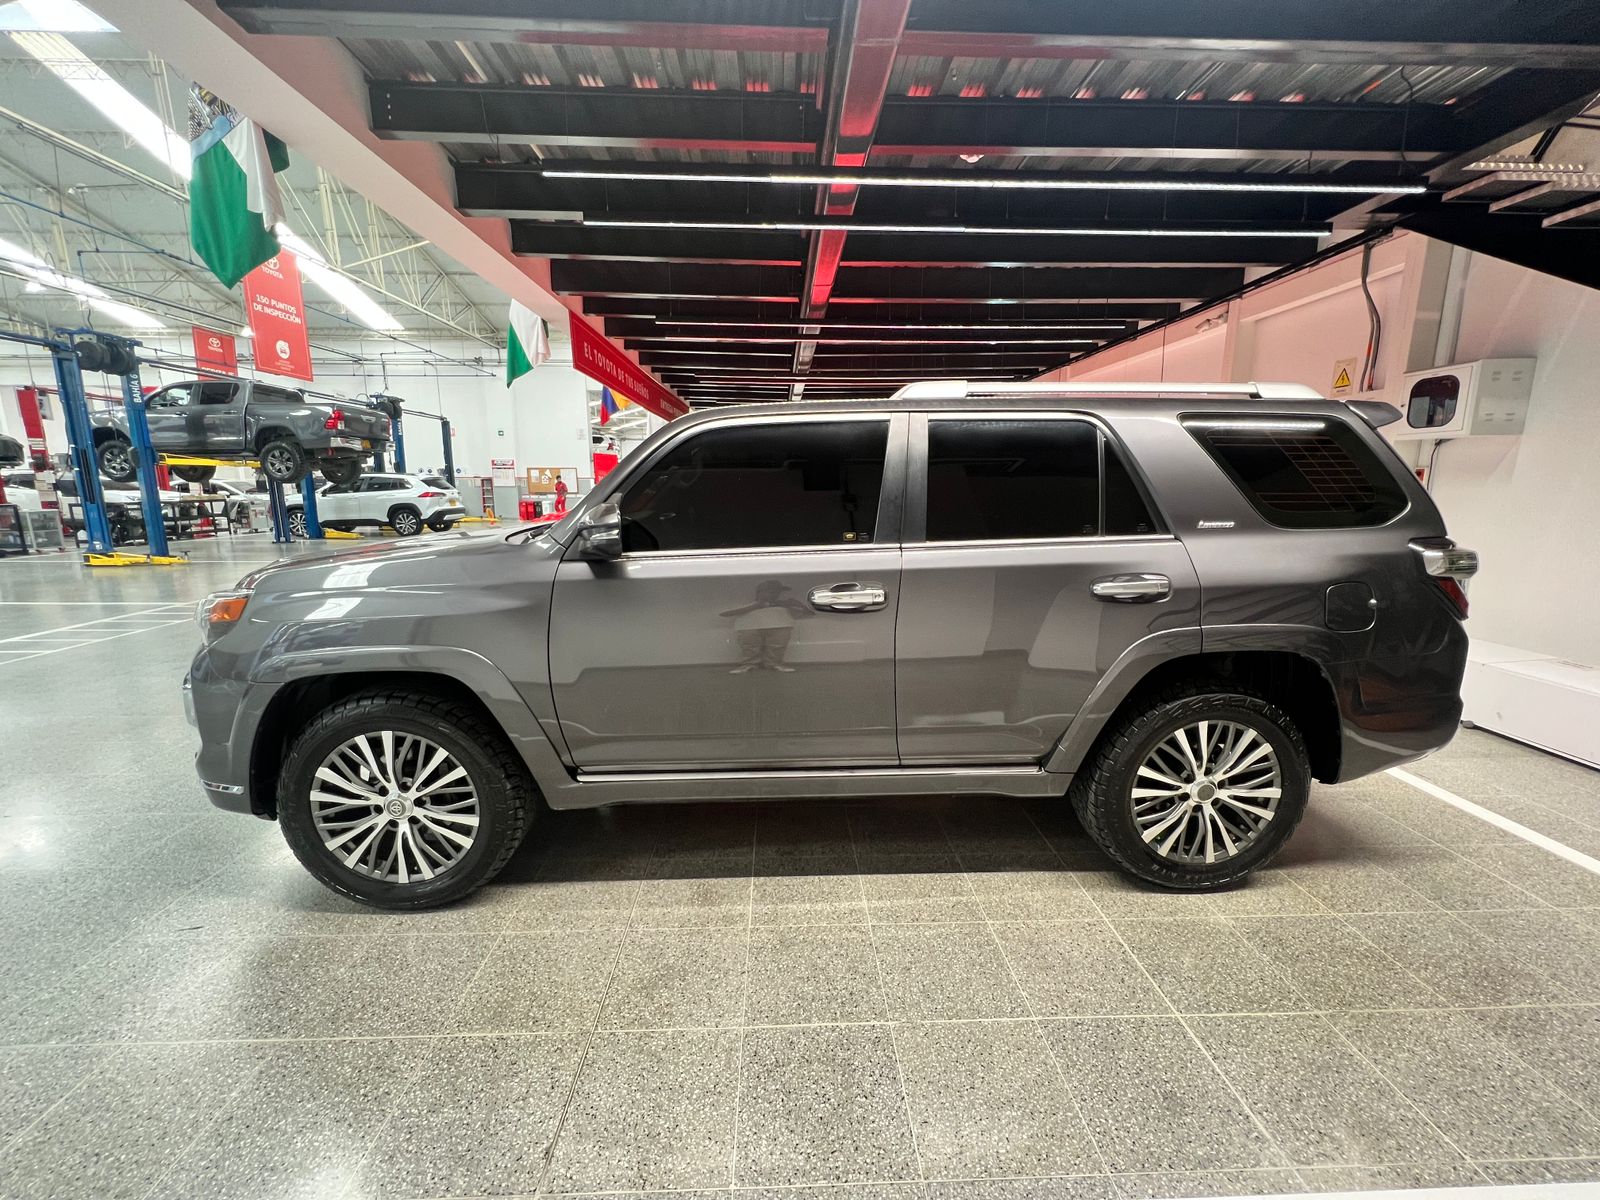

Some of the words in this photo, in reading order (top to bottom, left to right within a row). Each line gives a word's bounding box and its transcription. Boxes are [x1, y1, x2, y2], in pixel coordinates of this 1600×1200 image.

[261, 265, 284, 280] TOYOTA
[253, 302, 264, 313] DE
[264, 306, 302, 324] INSPECCIÓN
[256, 294, 270, 305] 150
[271, 298, 297, 314] PUNTOS
[583, 341, 593, 361] EL
[593, 349, 618, 378] TOYOTA
[617, 367, 626, 383] DE
[625, 373, 635, 389] TUS
[129, 380, 142, 403] BAHÍA
